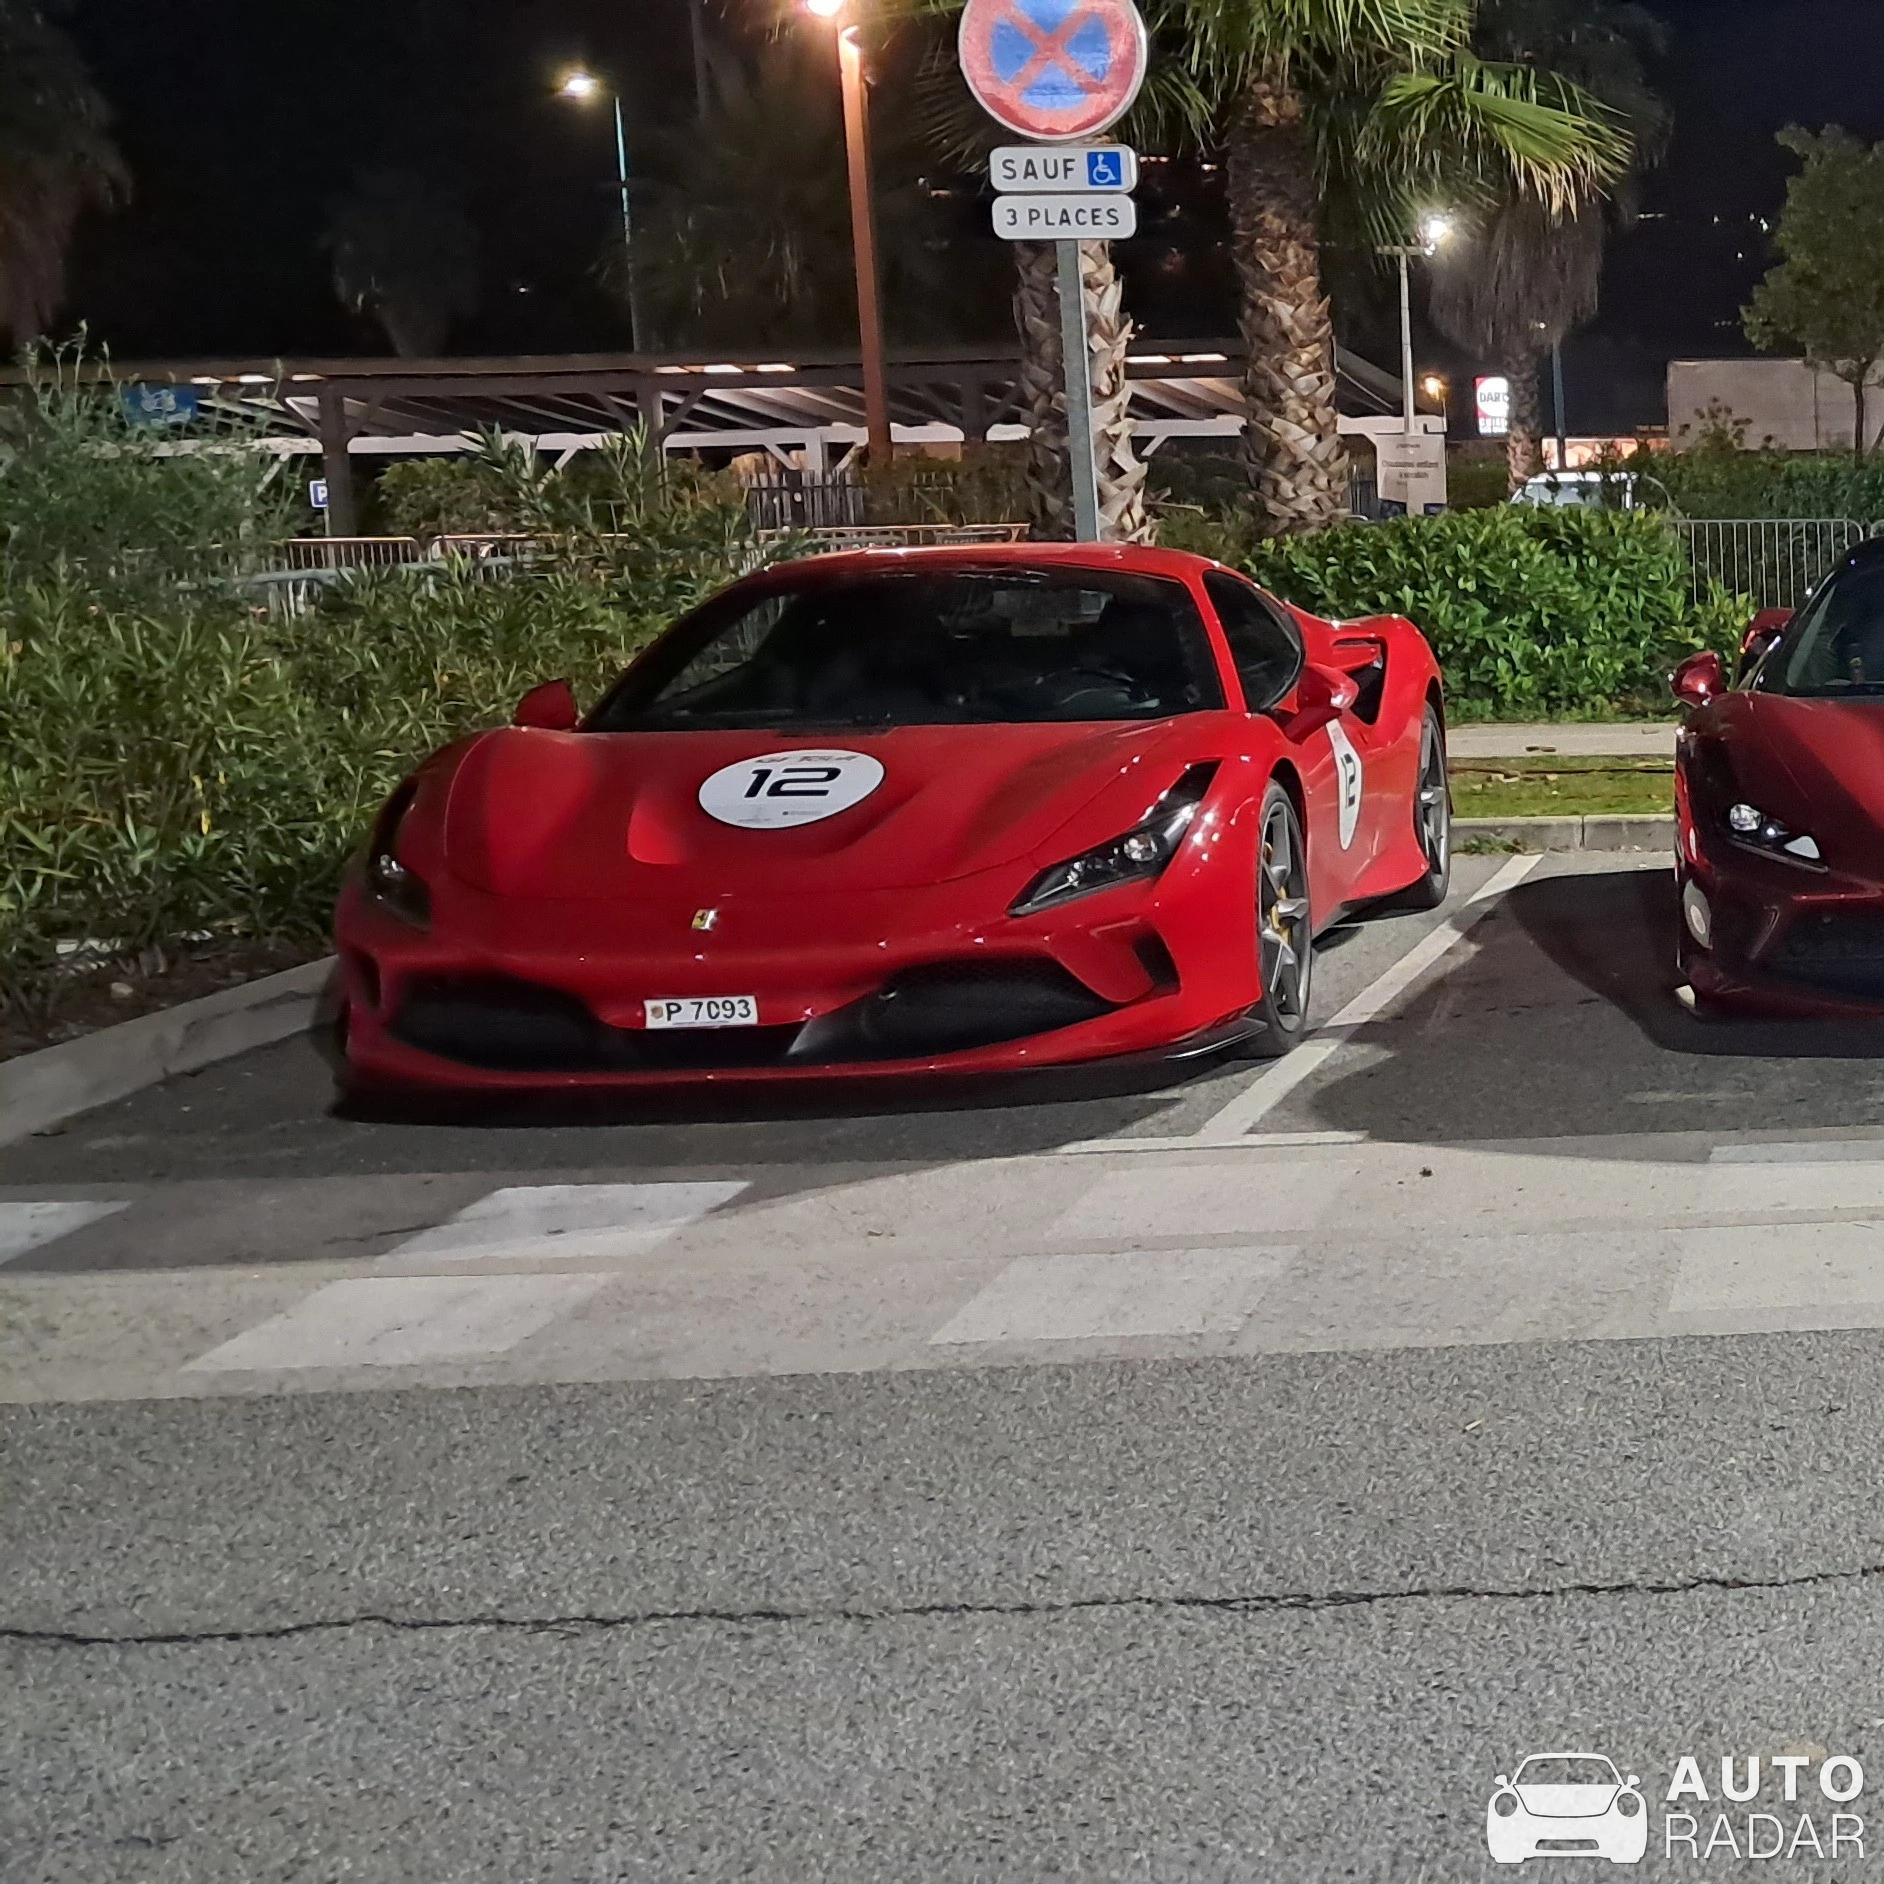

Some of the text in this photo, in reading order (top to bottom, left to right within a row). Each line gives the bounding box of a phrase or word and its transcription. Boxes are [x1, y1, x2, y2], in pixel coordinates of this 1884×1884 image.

[1002, 158, 1076, 180] SAUF
[1006, 208, 1120, 226] 3 PLACES
[316, 485, 328, 502] P
[744, 768, 841, 798] 12
[1340, 753, 1356, 809] 12
[665, 999, 752, 1021] P 7093
